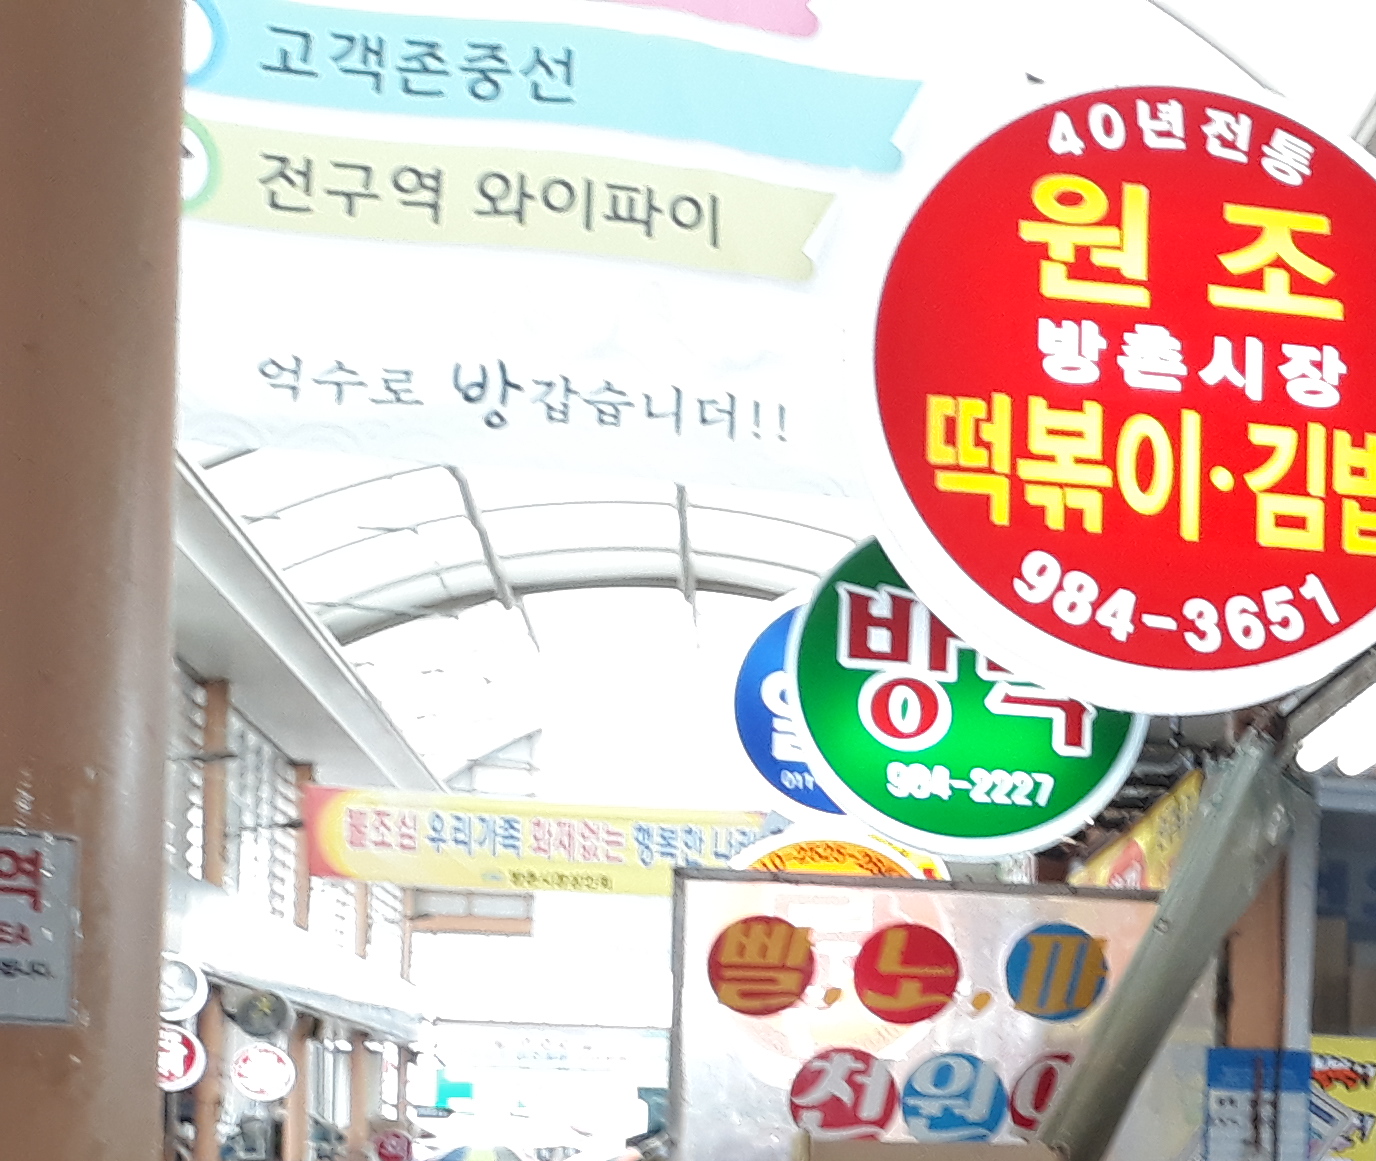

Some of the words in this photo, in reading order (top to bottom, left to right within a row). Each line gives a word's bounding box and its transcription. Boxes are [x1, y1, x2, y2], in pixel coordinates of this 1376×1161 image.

[261, 24, 577, 105] 고객존중선
[1047, 99, 1315, 187] 40년전통
[259, 152, 443, 224] 전구역
[475, 170, 720, 249] 와이파이
[257, 353, 425, 407] 억수로
[453, 359, 789, 443] 방갑습니더!!
[1037, 317, 1348, 409] 방촌시장
[1013, 549, 1341, 654] 984-3651
[885, 761, 1055, 807] 984-2227
[426, 811, 521, 858] 우리가족
